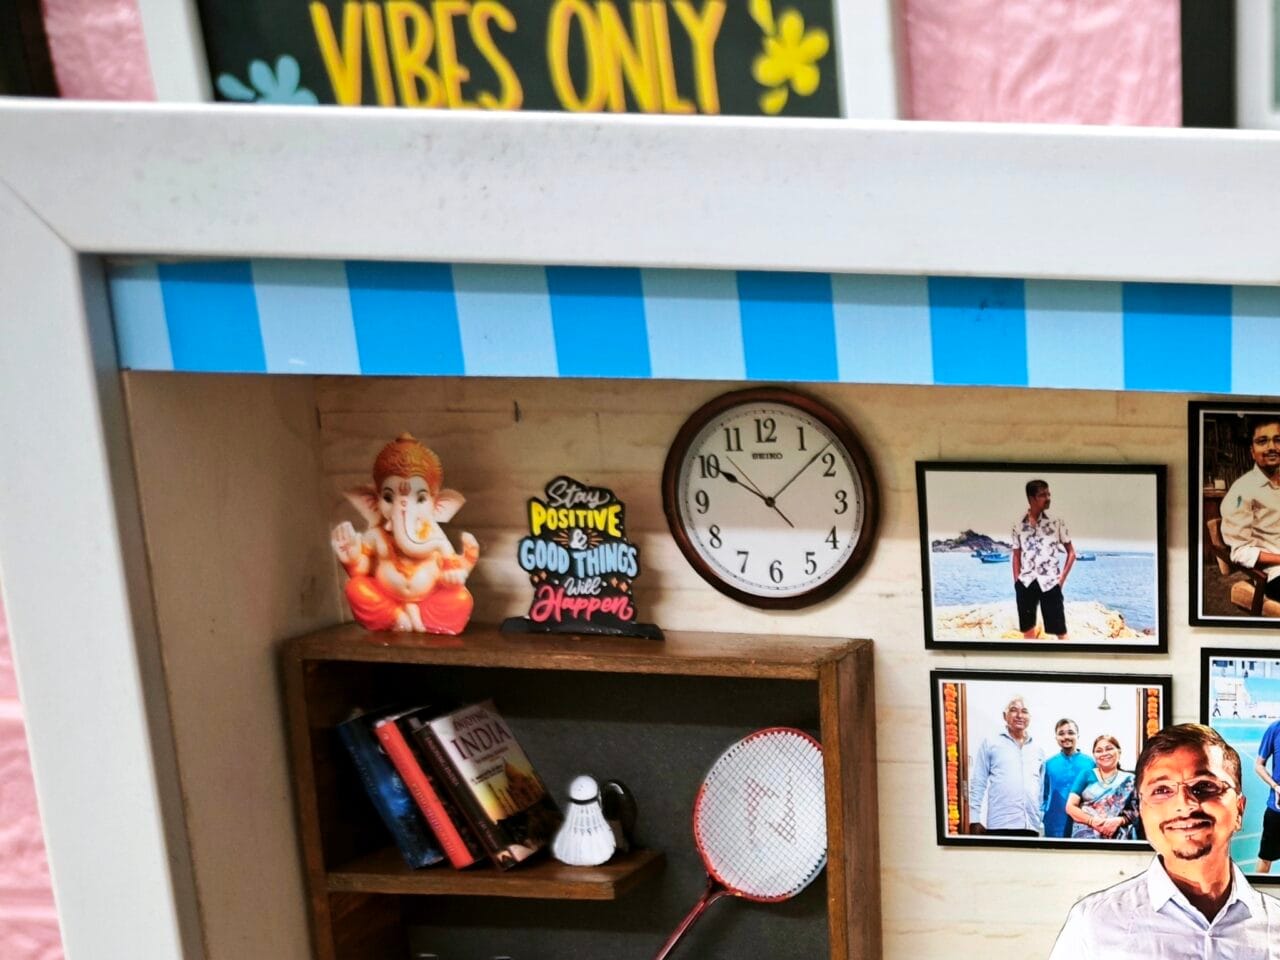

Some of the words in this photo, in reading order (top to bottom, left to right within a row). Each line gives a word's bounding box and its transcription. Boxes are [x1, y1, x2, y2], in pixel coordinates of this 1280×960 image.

[310, 1, 523, 111] VIBES
[547, 0, 725, 114] ONLY
[724, 427, 744, 452] 11
[754, 418, 777, 443] 12
[797, 426, 807, 451] 1
[700, 454, 720, 479] 10
[821, 453, 836, 477] 2
[548, 480, 610, 508] Stay
[695, 490, 709, 514] 9
[834, 490, 848, 514] 3
[530, 501, 622, 538] POSITIVE
[570, 529, 587, 550] &
[709, 524, 722, 549] 8
[825, 526, 839, 550] 4
[520, 539, 570, 574] GOOD
[573, 543, 638, 578] THINGS
[736, 550, 749, 574] 7
[804, 551, 817, 575] 5
[769, 560, 784, 584] 6
[564, 577, 601, 595] Will
[530, 585, 633, 622] Happen
[450, 721, 512, 760] INDIA
